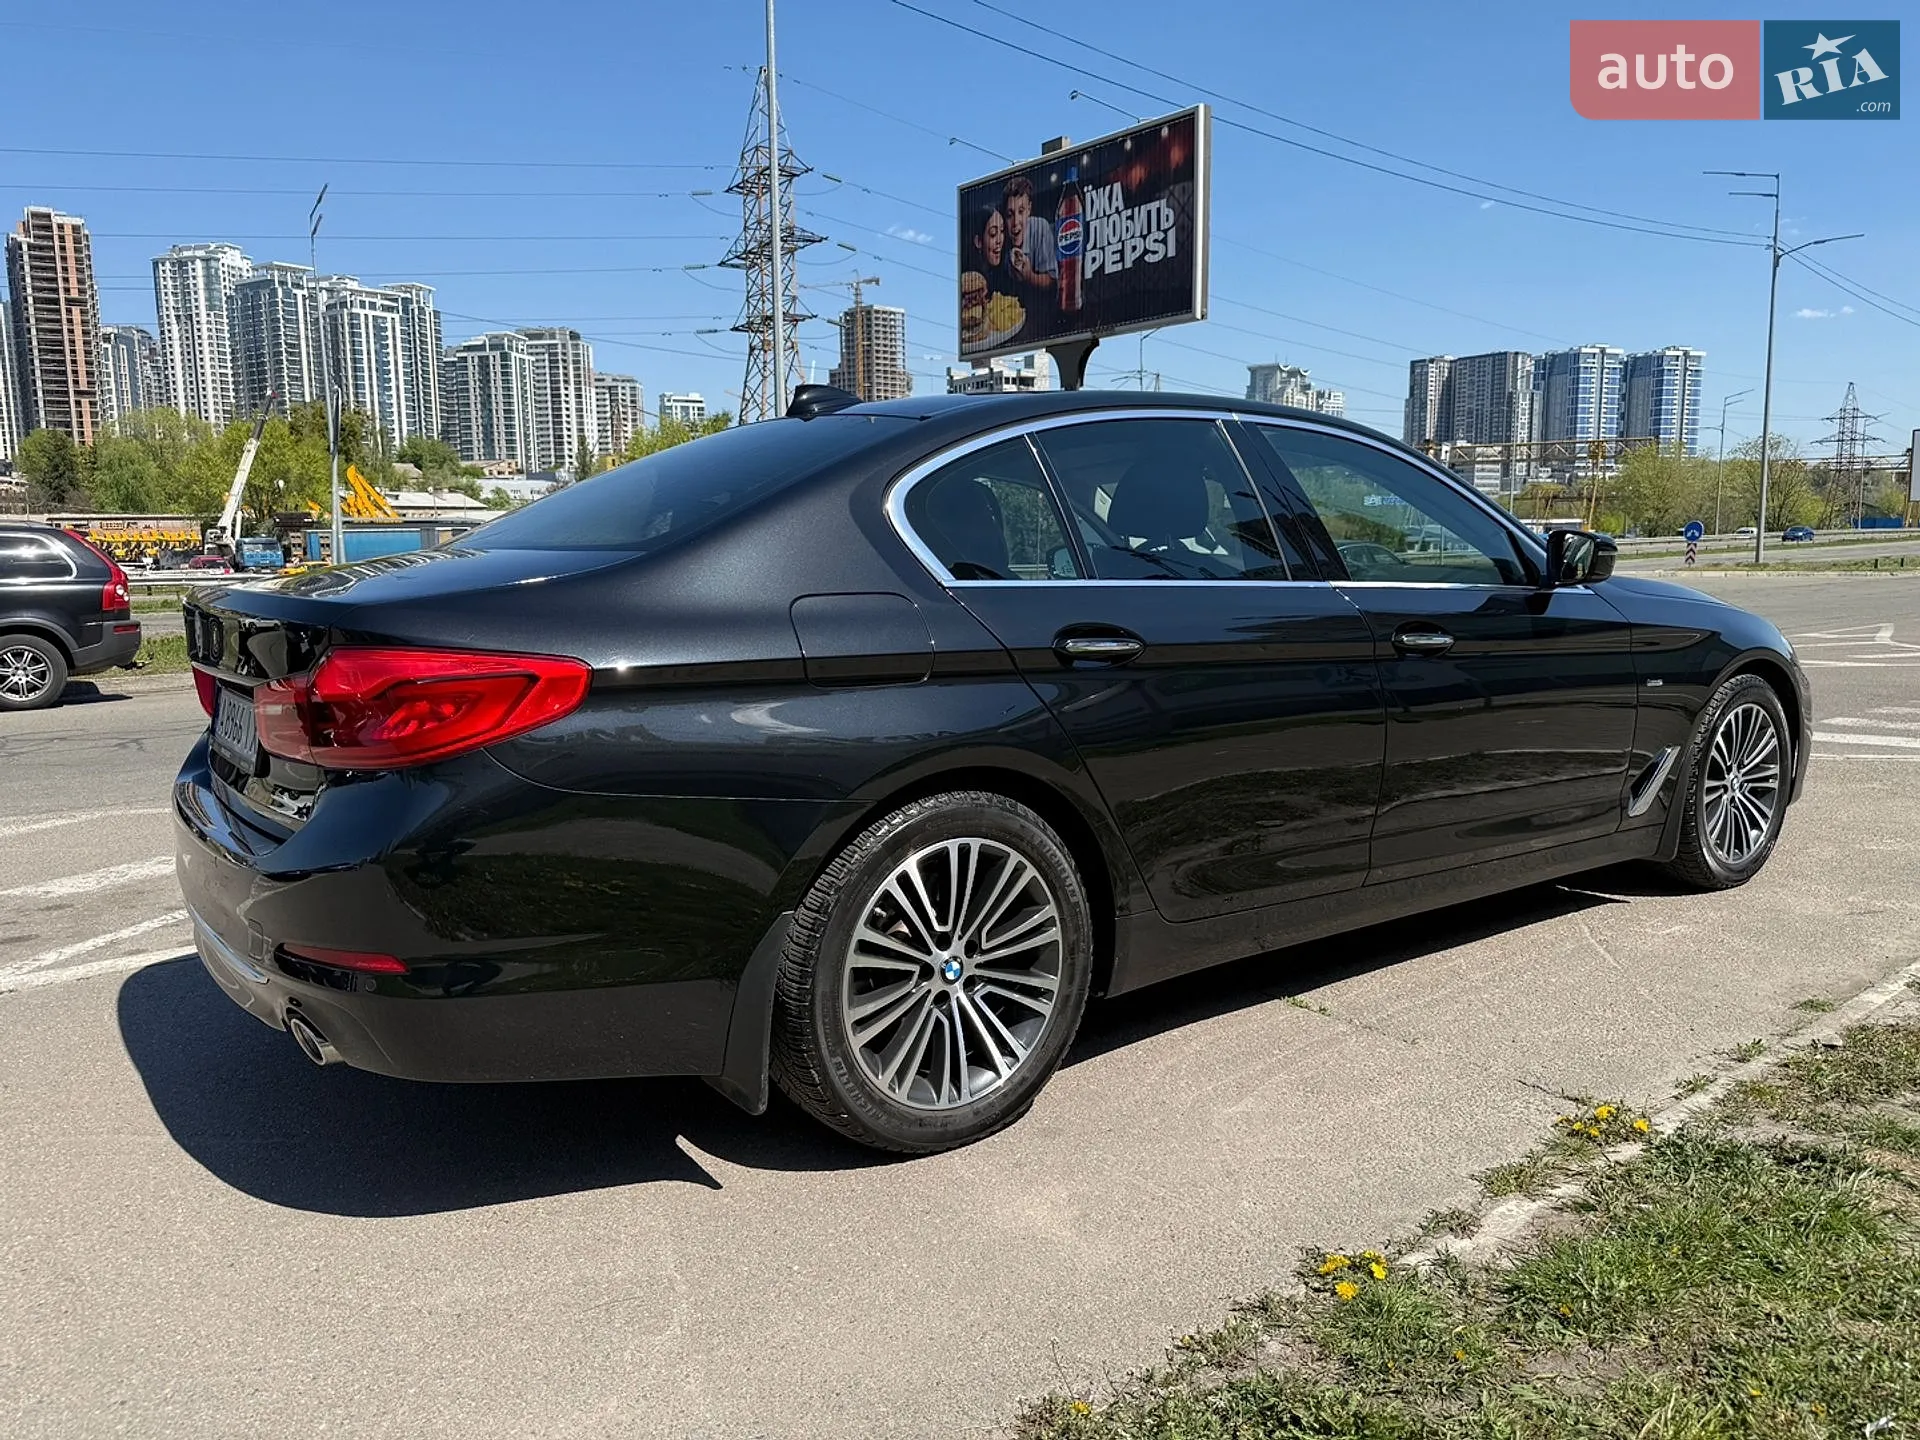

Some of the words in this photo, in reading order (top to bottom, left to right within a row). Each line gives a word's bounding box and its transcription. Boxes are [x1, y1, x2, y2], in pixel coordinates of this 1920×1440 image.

[1084, 182, 1125, 221] ЇЖА
[1086, 199, 1175, 251] ЛЮБИТЬ
[1084, 227, 1176, 279] PEPSI
